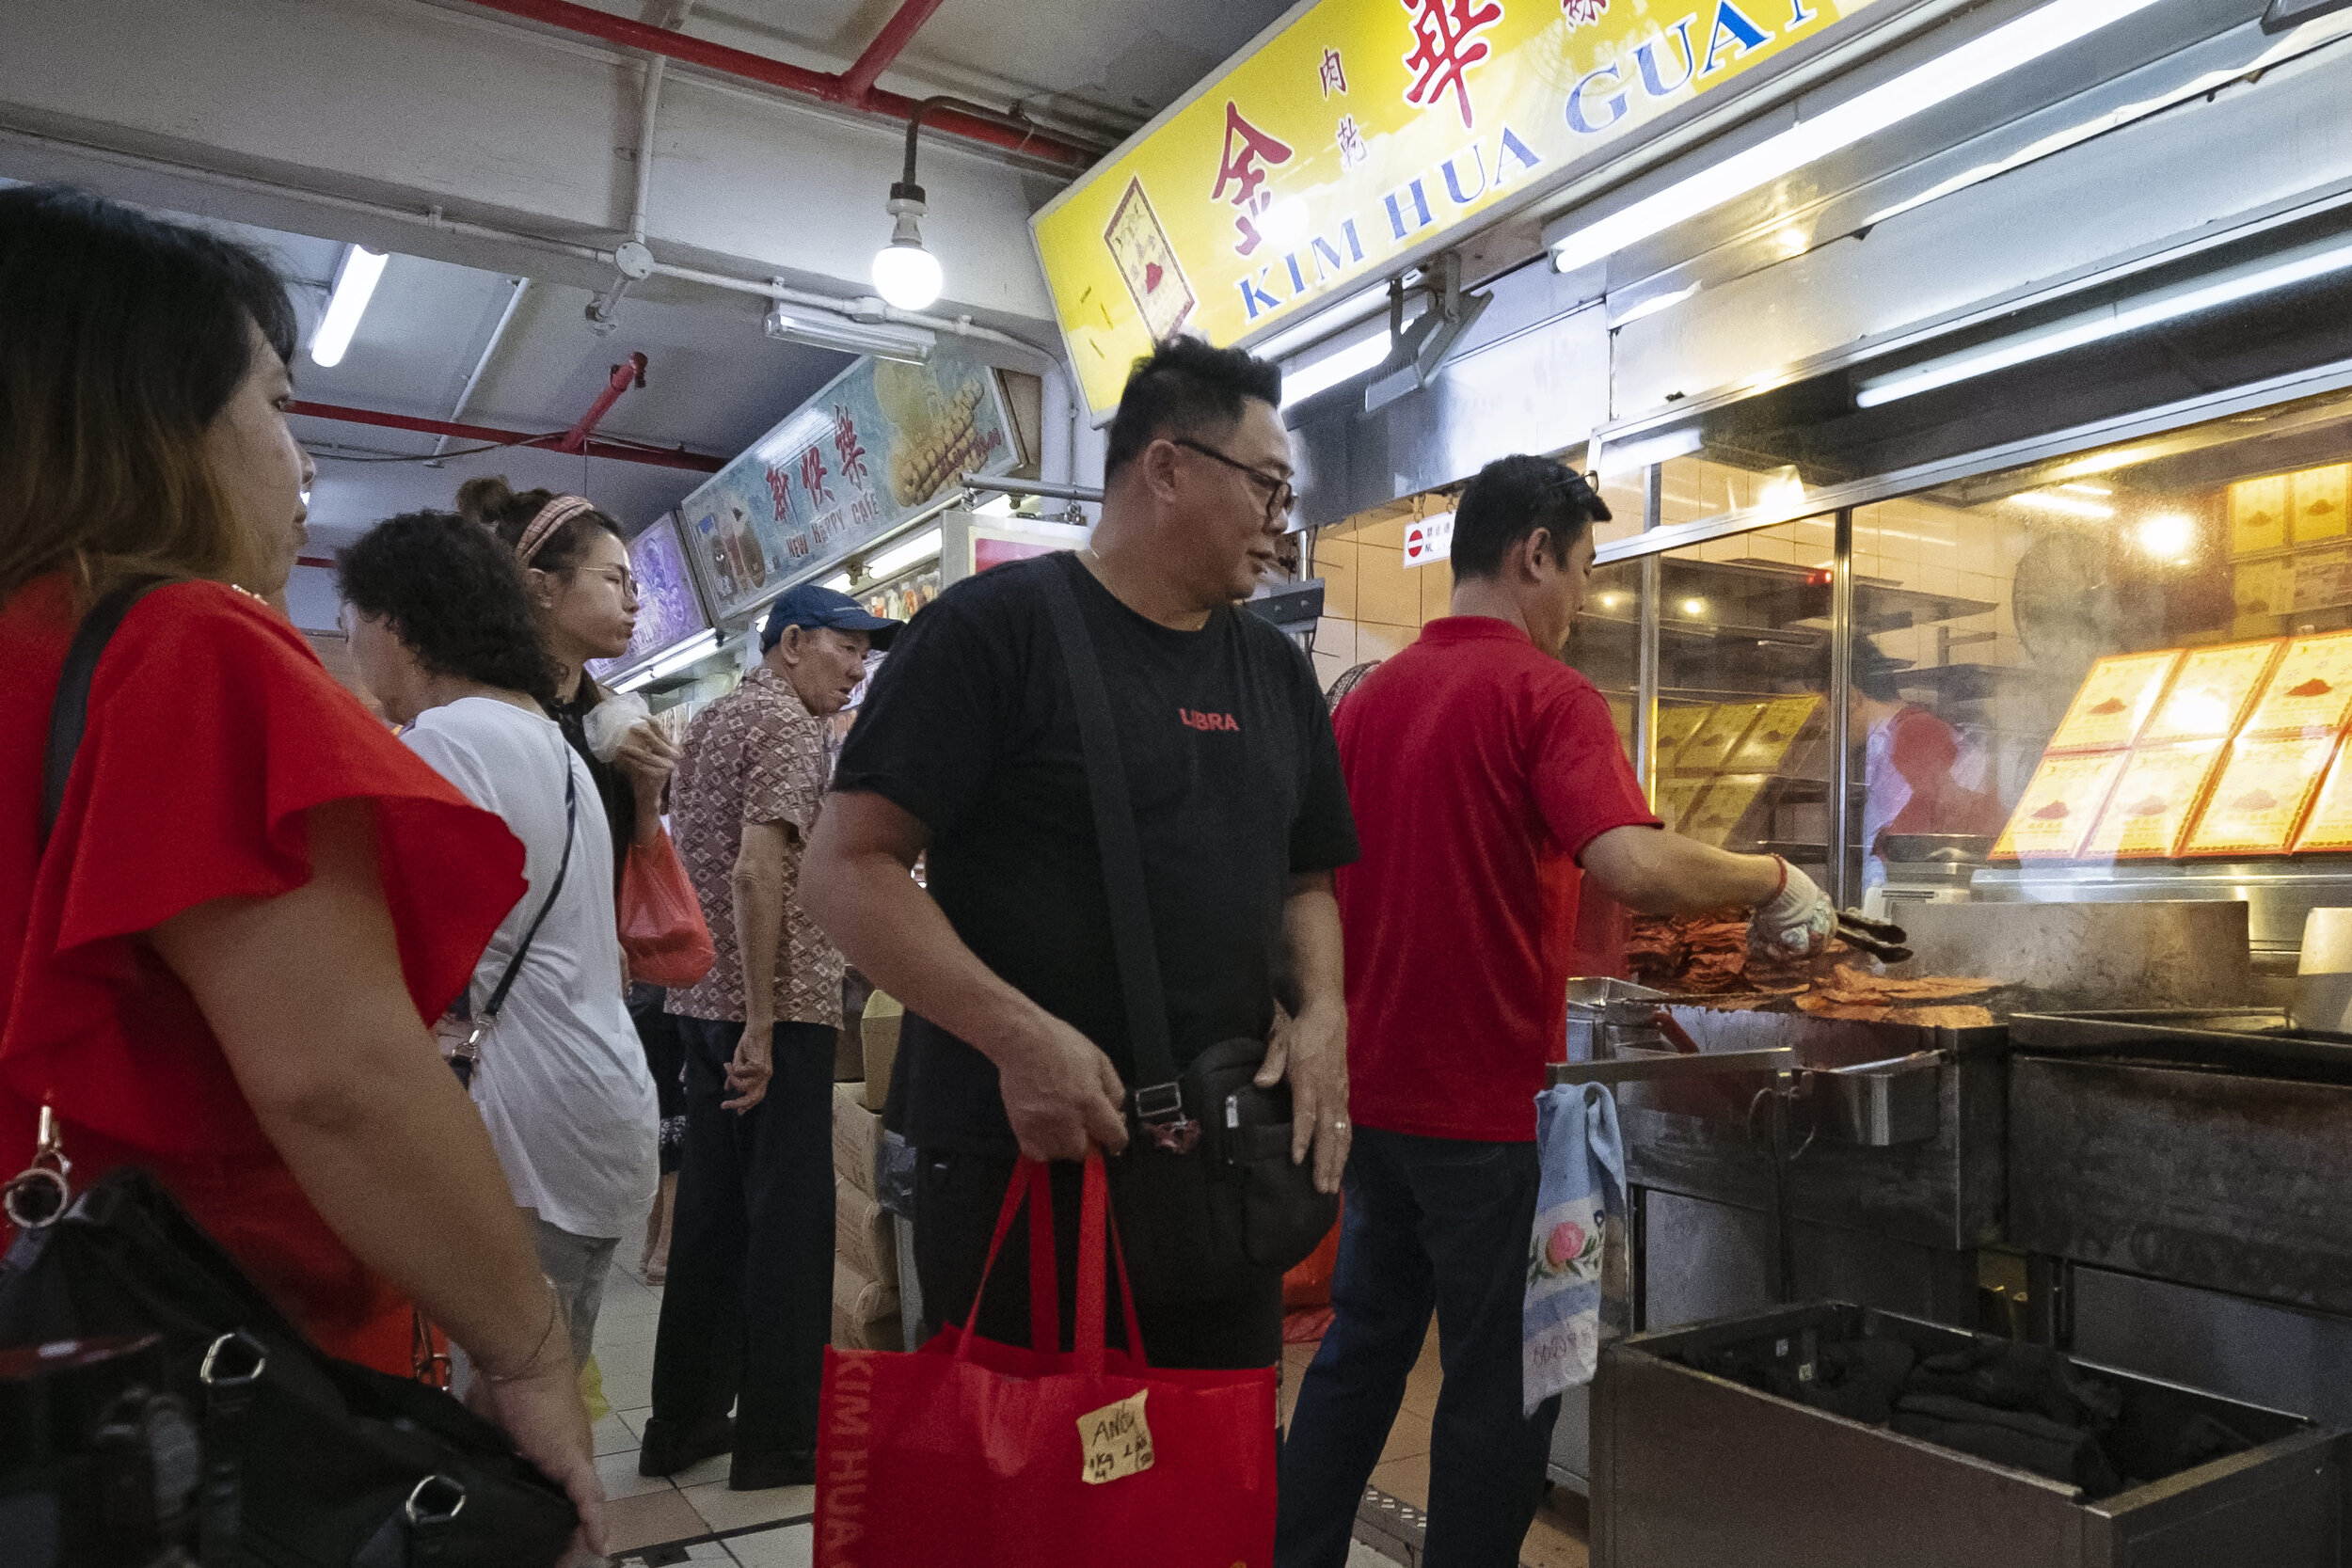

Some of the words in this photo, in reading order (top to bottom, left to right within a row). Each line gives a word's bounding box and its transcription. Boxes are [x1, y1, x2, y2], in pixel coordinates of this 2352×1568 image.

[1238, 217, 1365, 319] KIM
[1383, 126, 1541, 240] HUA
[786, 532, 809, 558] NEW
[811, 508, 846, 545] HAPPY
[1179, 707, 1241, 732] LIBRA
[831, 1349, 873, 1436] KIM
[821, 1449, 868, 1552] HUA
